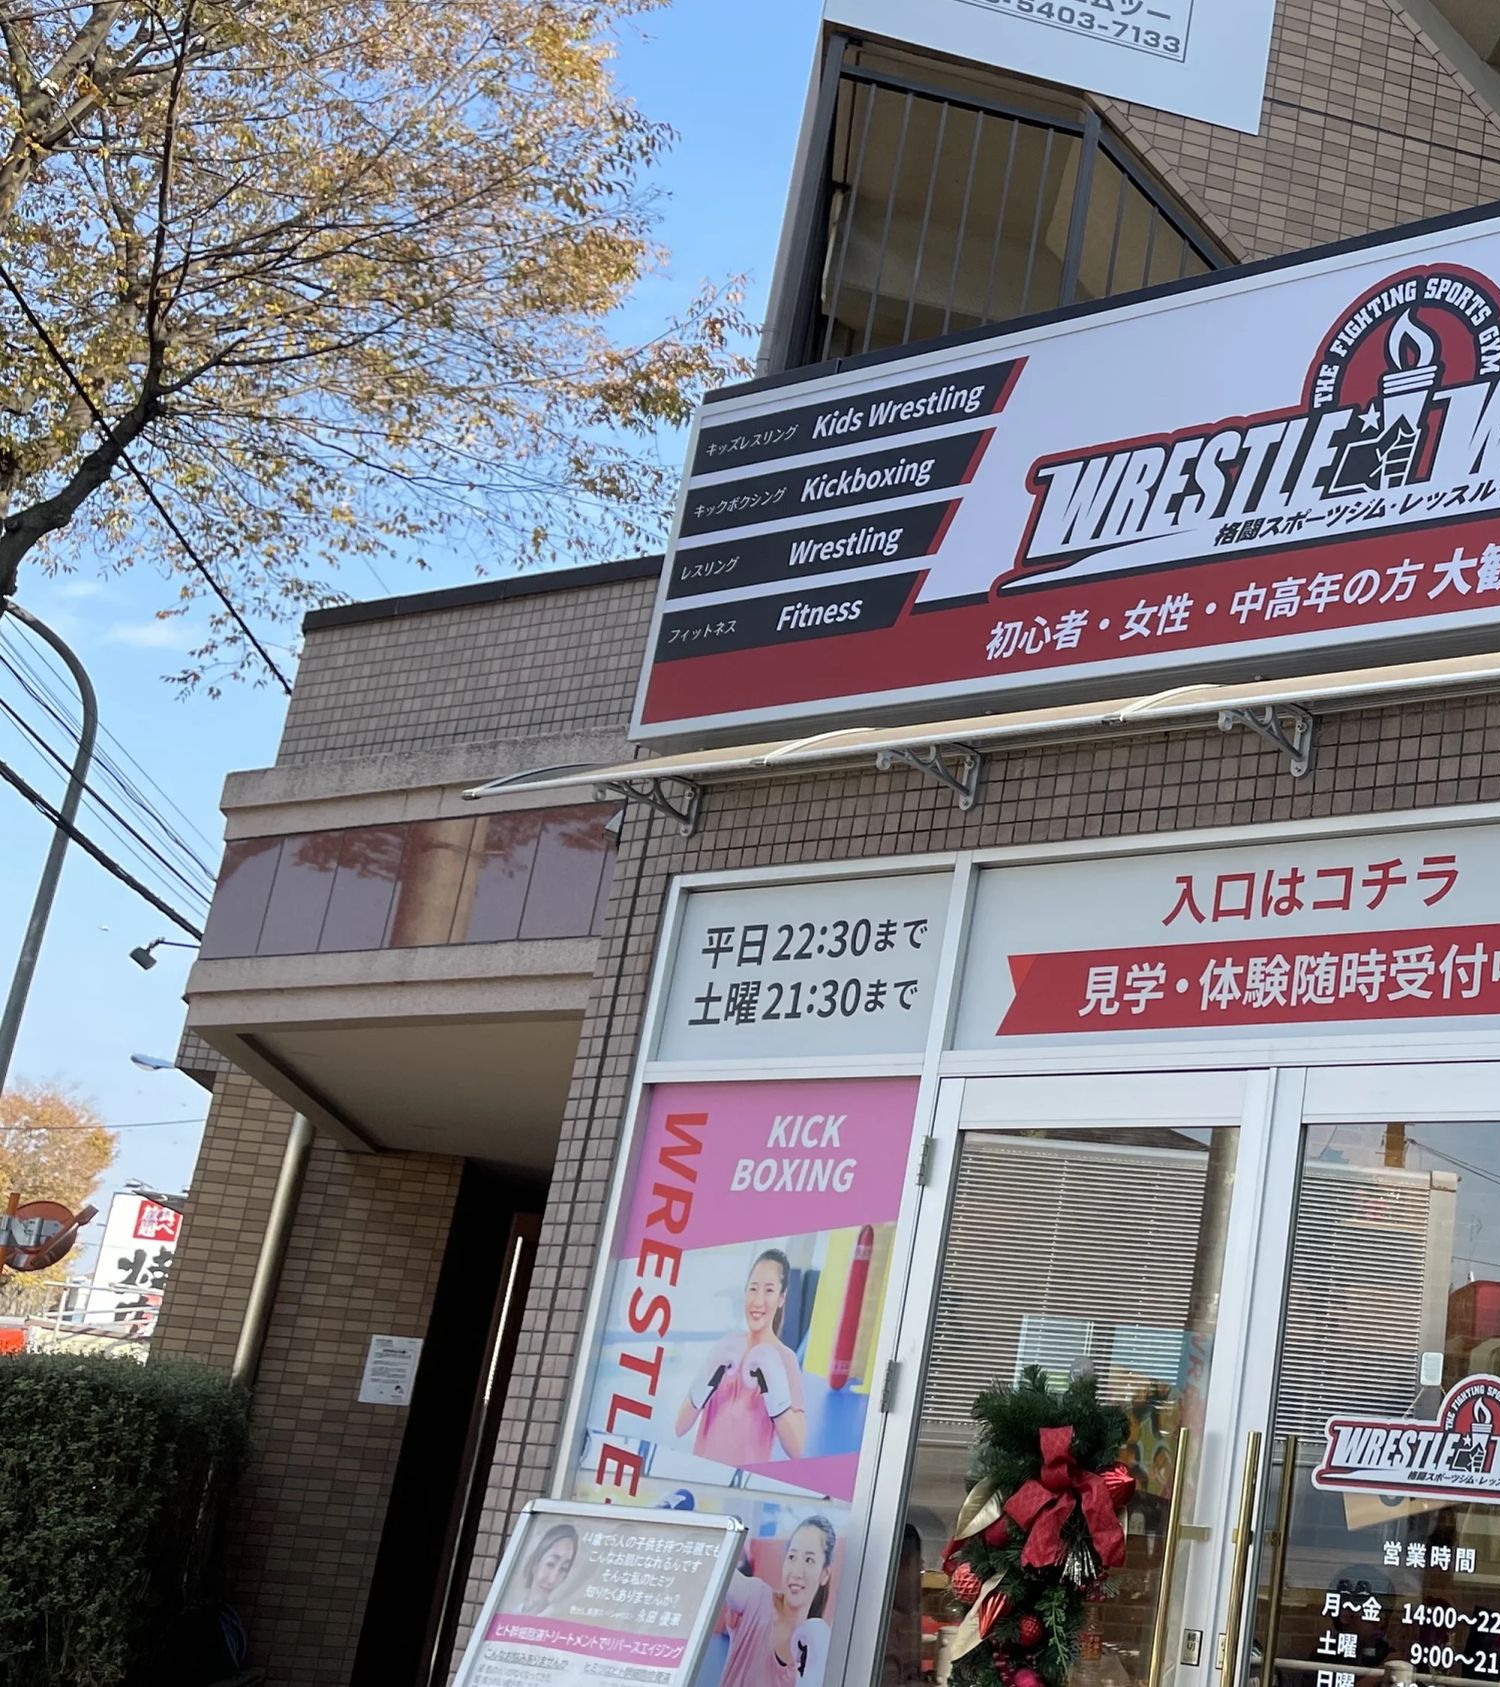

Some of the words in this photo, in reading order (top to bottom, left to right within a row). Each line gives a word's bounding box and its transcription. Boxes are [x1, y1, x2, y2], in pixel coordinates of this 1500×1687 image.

[1313, 364, 1340, 409] THE
[1329, 280, 1417, 357] FIGHTING
[1424, 278, 1493, 326] SPORTS
[705, 424, 799, 457] キッズレスリング
[811, 408, 862, 440] Kids
[868, 382, 986, 430] Wrestling
[693, 486, 788, 518] キックボクシング
[800, 454, 936, 503] Kickboxing
[1028, 407, 1356, 560] WRESTLE
[680, 556, 740, 581] レスリング
[788, 523, 904, 568] Wrestling
[668, 619, 738, 645] フィットネス
[776, 597, 863, 632] Fitness
[1161, 854, 1460, 927] 入口はコチラ
[702, 917, 928, 969] 平日22:30まで
[688, 977, 919, 1026] 土曜21:30まで
[767, 1114, 848, 1149] KICK
[730, 1157, 858, 1194] BOXING
[1328, 1426, 1461, 1478] WRESTLE
[1382, 1541, 1477, 1574] 営業時間
[1317, 1630, 1358, 1659] 土曜
